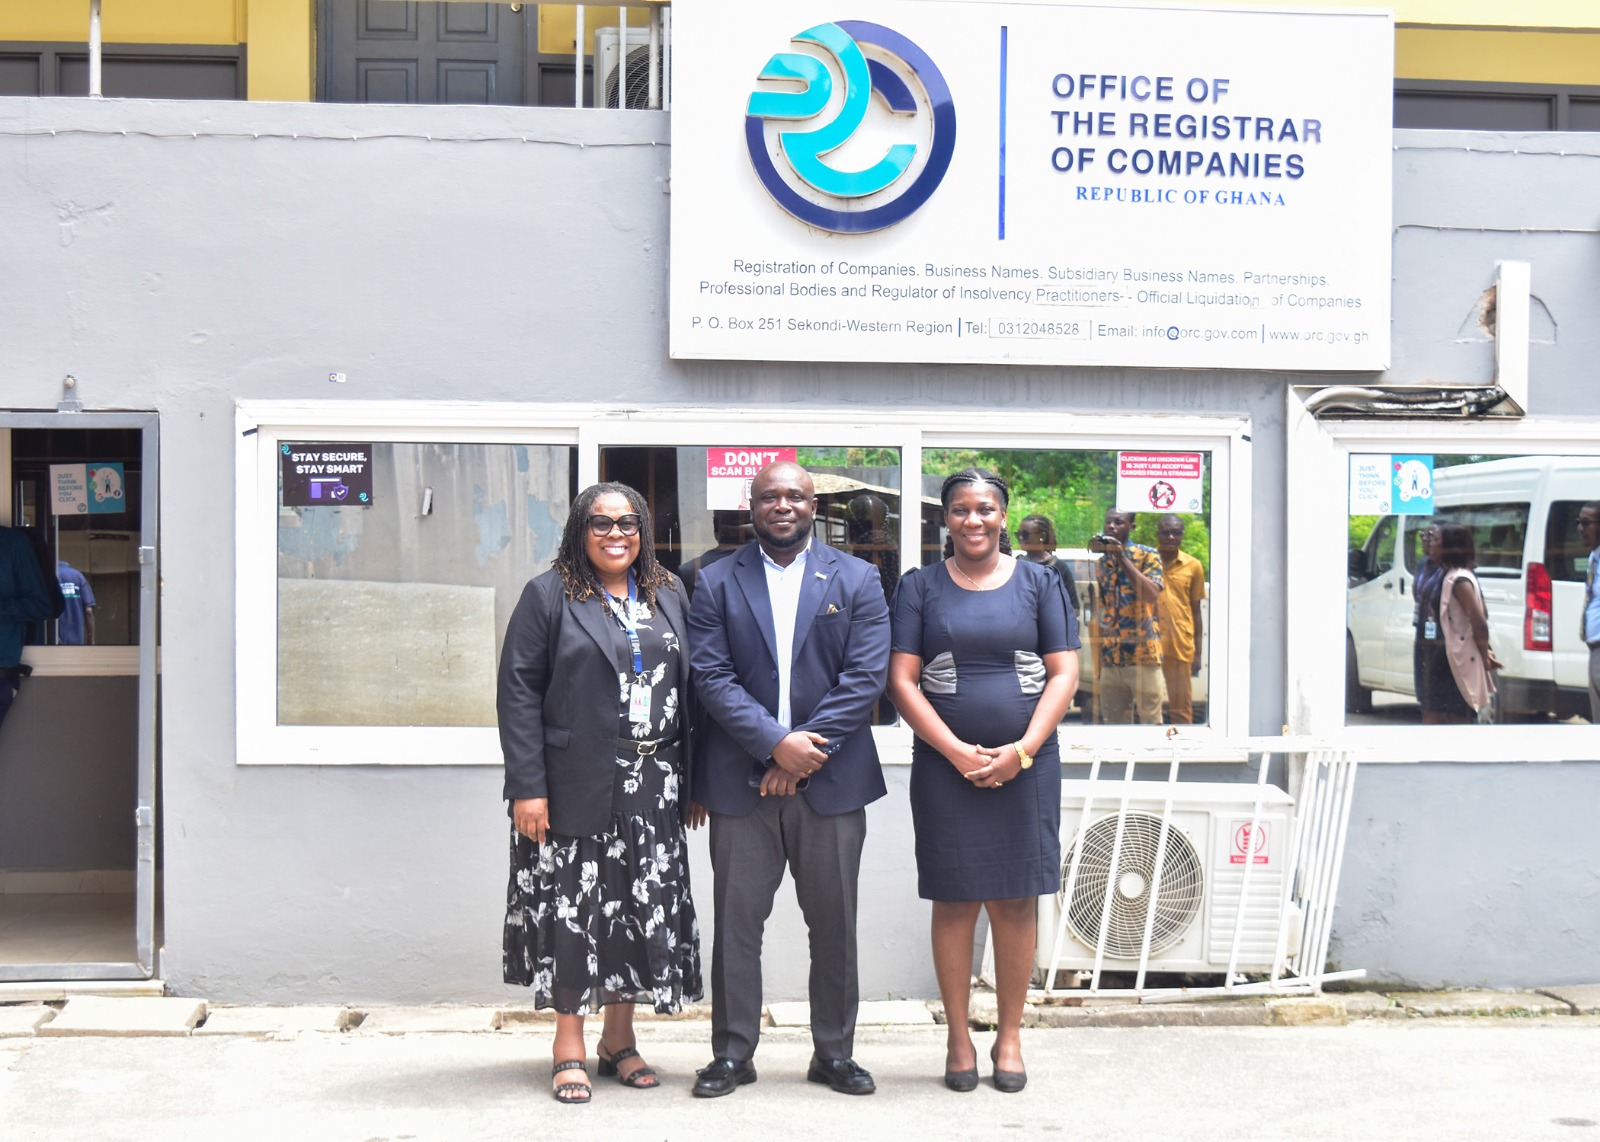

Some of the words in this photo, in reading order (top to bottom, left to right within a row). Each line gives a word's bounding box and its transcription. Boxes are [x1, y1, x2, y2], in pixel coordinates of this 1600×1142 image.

[1052, 73, 1174, 101] OFFICE
[1186, 77, 1230, 104] OF
[1051, 110, 1116, 136] THE
[1129, 112, 1322, 143] REGISTRAR
[1051, 146, 1095, 172] OF
[1107, 148, 1305, 180] COMPANIES
[1076, 186, 1178, 203] REPUBLIC
[1184, 189, 1210, 204] OF
[1215, 190, 1286, 206] GHANA
[733, 259, 816, 277] Registration
[820, 261, 834, 275] of
[838, 261, 920, 279] Companies.
[925, 263, 987, 278] Business
[991, 265, 1043, 279] Names.
[1048, 266, 1119, 284] Subsidiary
[1123, 268, 1184, 283] Business
[699, 281, 785, 297] Professional
[790, 282, 837, 297] Bodies
[841, 284, 867, 298] and
[872, 284, 938, 301] Regulator
[942, 286, 956, 299] of
[960, 286, 1032, 303] Insolvency
[1137, 290, 1182, 304] Official
[1187, 291, 1260, 307] Liquidation
[1271, 293, 1284, 306] of
[1287, 293, 1362, 309] Companies
[692, 316, 704, 328] P.
[708, 316, 723, 329] O.
[728, 317, 754, 330] Box
[758, 318, 782, 330] 251
[787, 318, 902, 332] Sekondi-Western
[906, 320, 953, 336] Region
[965, 321, 987, 334] Tel:
[998, 322, 1080, 336] 0312048528
[1098, 324, 1138, 338] Email:
[1142, 325, 1257, 342] info@orc.gov.com
[291, 453, 320, 462] STAY
[322, 452, 367, 463] SECURE,
[724, 451, 779, 466] DON'T
[296, 465, 325, 474] STAY
[326, 464, 363, 474] SMART
[711, 467, 742, 476] SCAN
